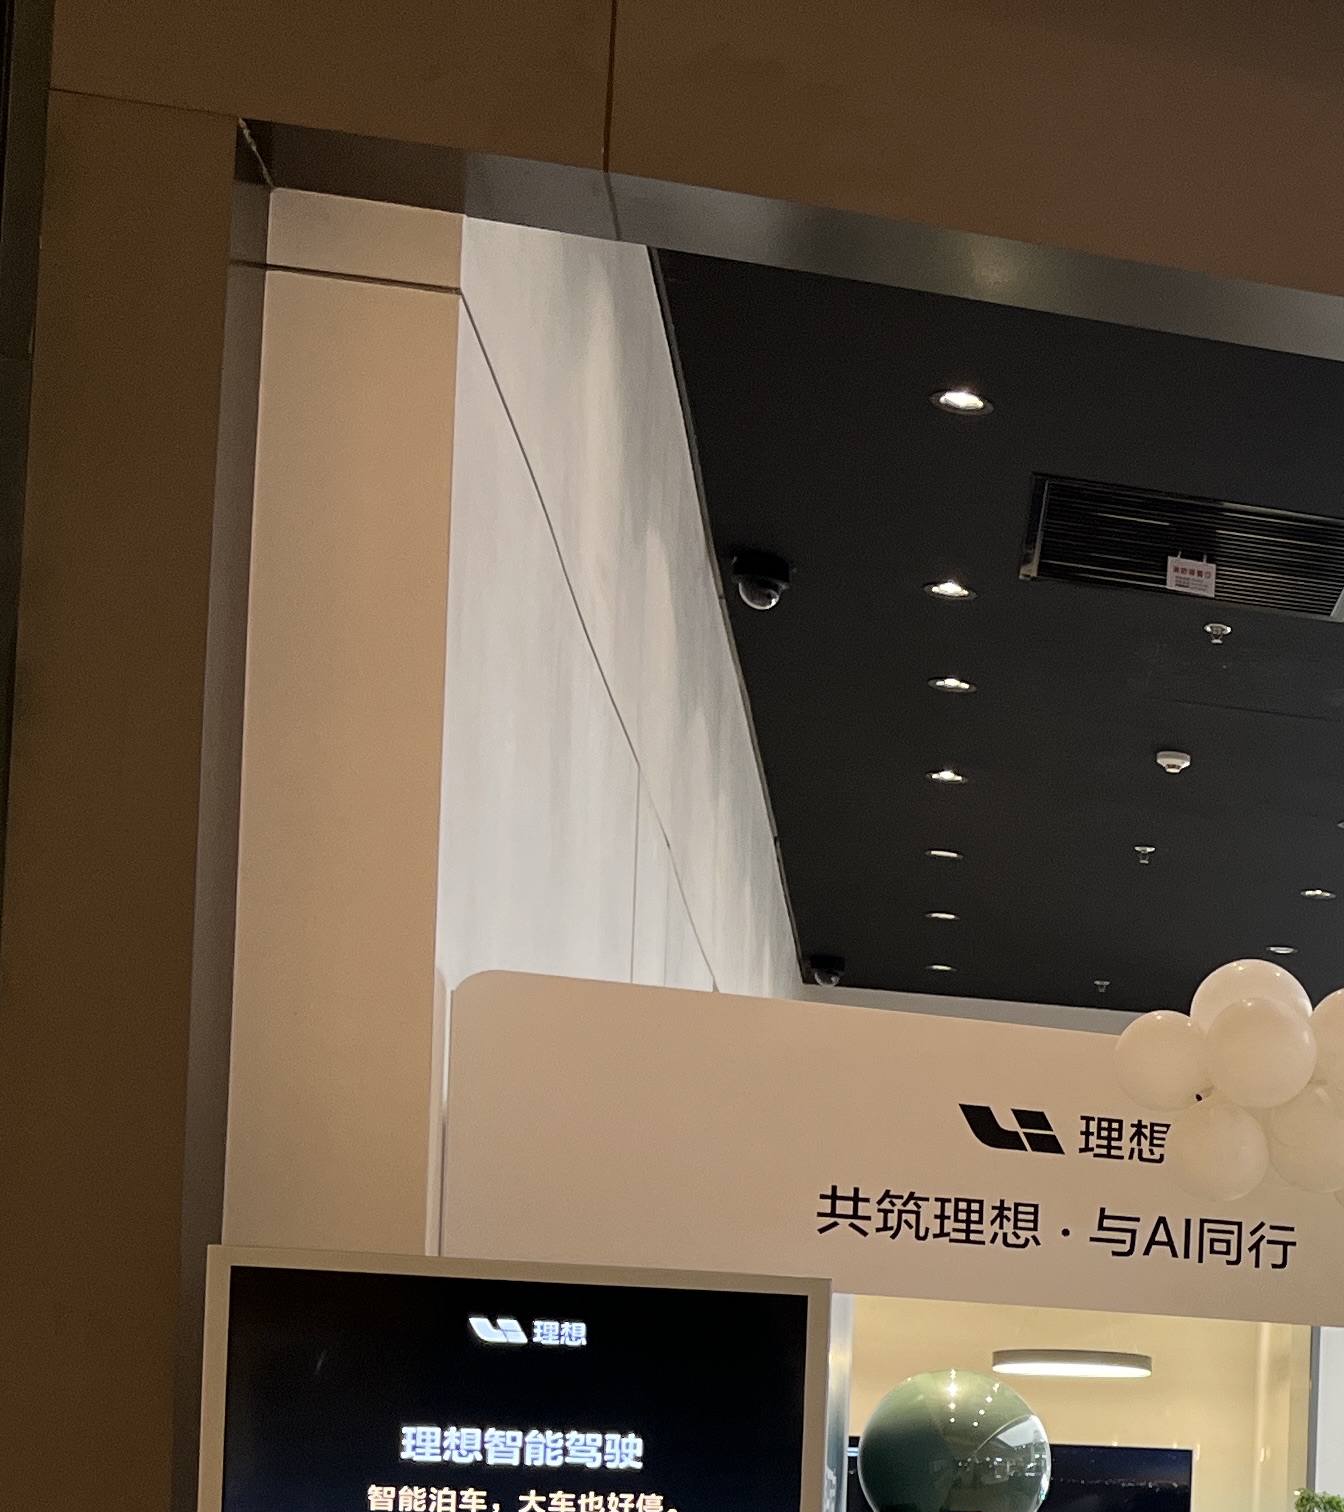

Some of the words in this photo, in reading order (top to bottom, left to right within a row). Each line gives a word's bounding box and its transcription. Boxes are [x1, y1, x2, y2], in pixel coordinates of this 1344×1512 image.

[1078, 1115, 1172, 1164] 理想
[533, 1319, 588, 1347] 理想
[400, 1425, 644, 1470] 理想智能驾驶
